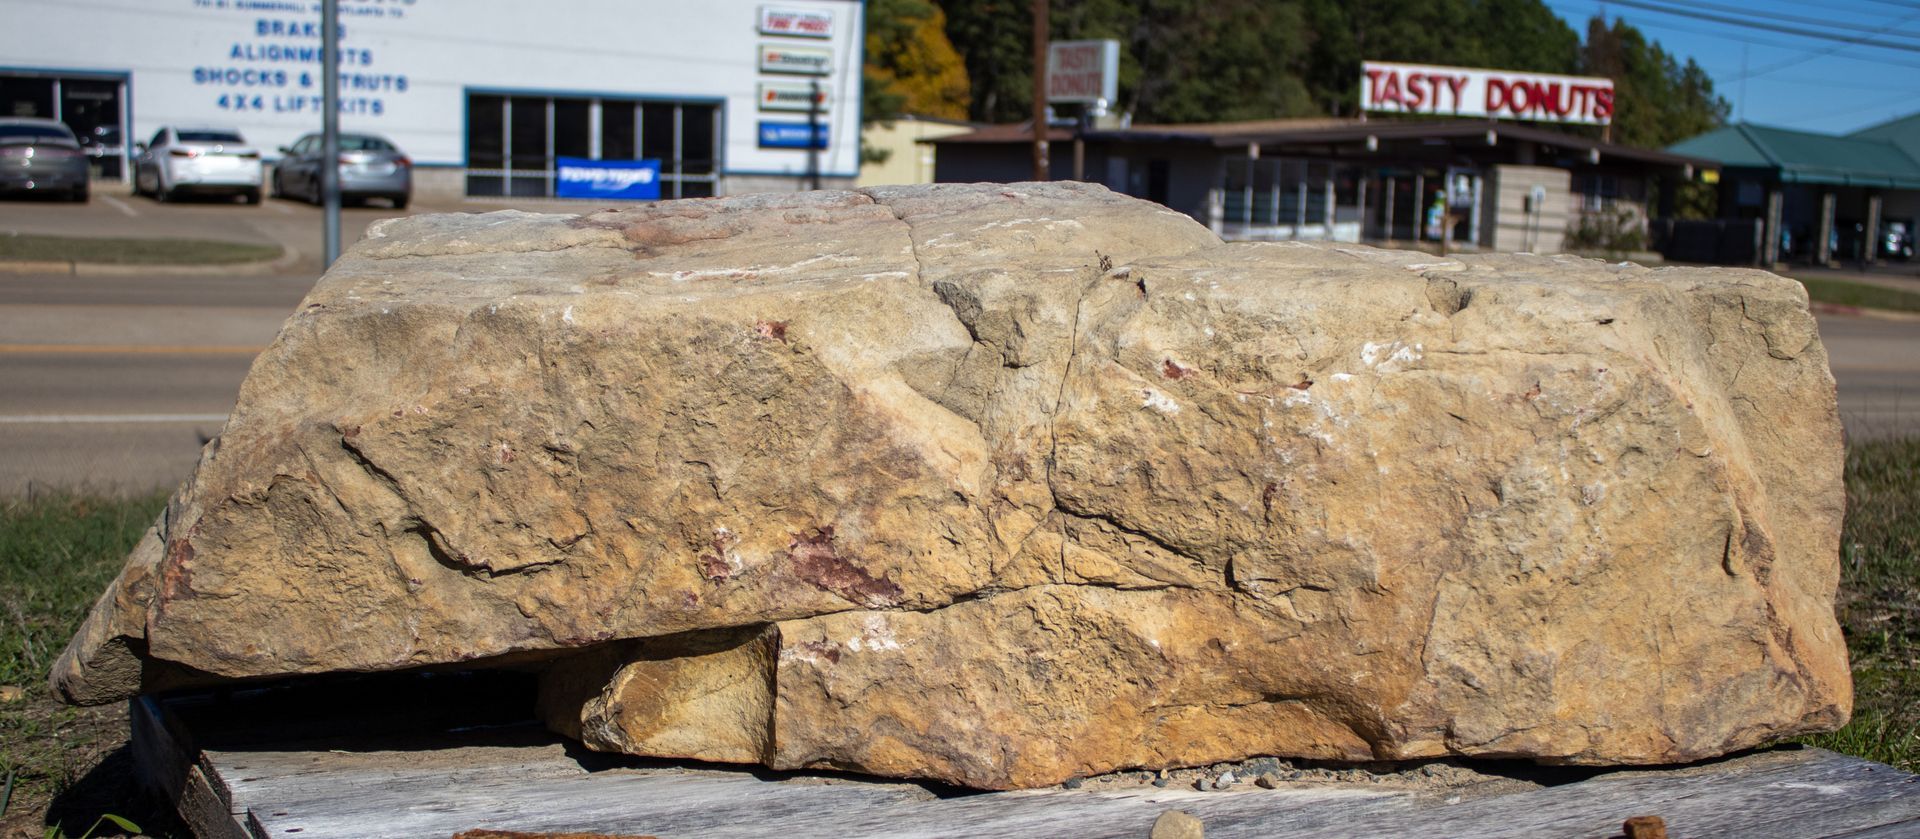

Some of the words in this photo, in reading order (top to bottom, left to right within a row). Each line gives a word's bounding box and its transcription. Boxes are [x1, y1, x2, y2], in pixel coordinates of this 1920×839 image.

[255, 19, 346, 40] BRAKS
[193, 67, 288, 86] SHOCKS
[300, 73, 313, 88] &
[338, 75, 409, 92] TRUTS
[217, 94, 265, 110] 4X4
[273, 97, 323, 112] LIFT
[337, 99, 384, 115] KITS
[1366, 70, 1469, 112] TASTY
[1485, 78, 1614, 119] DONUTS
